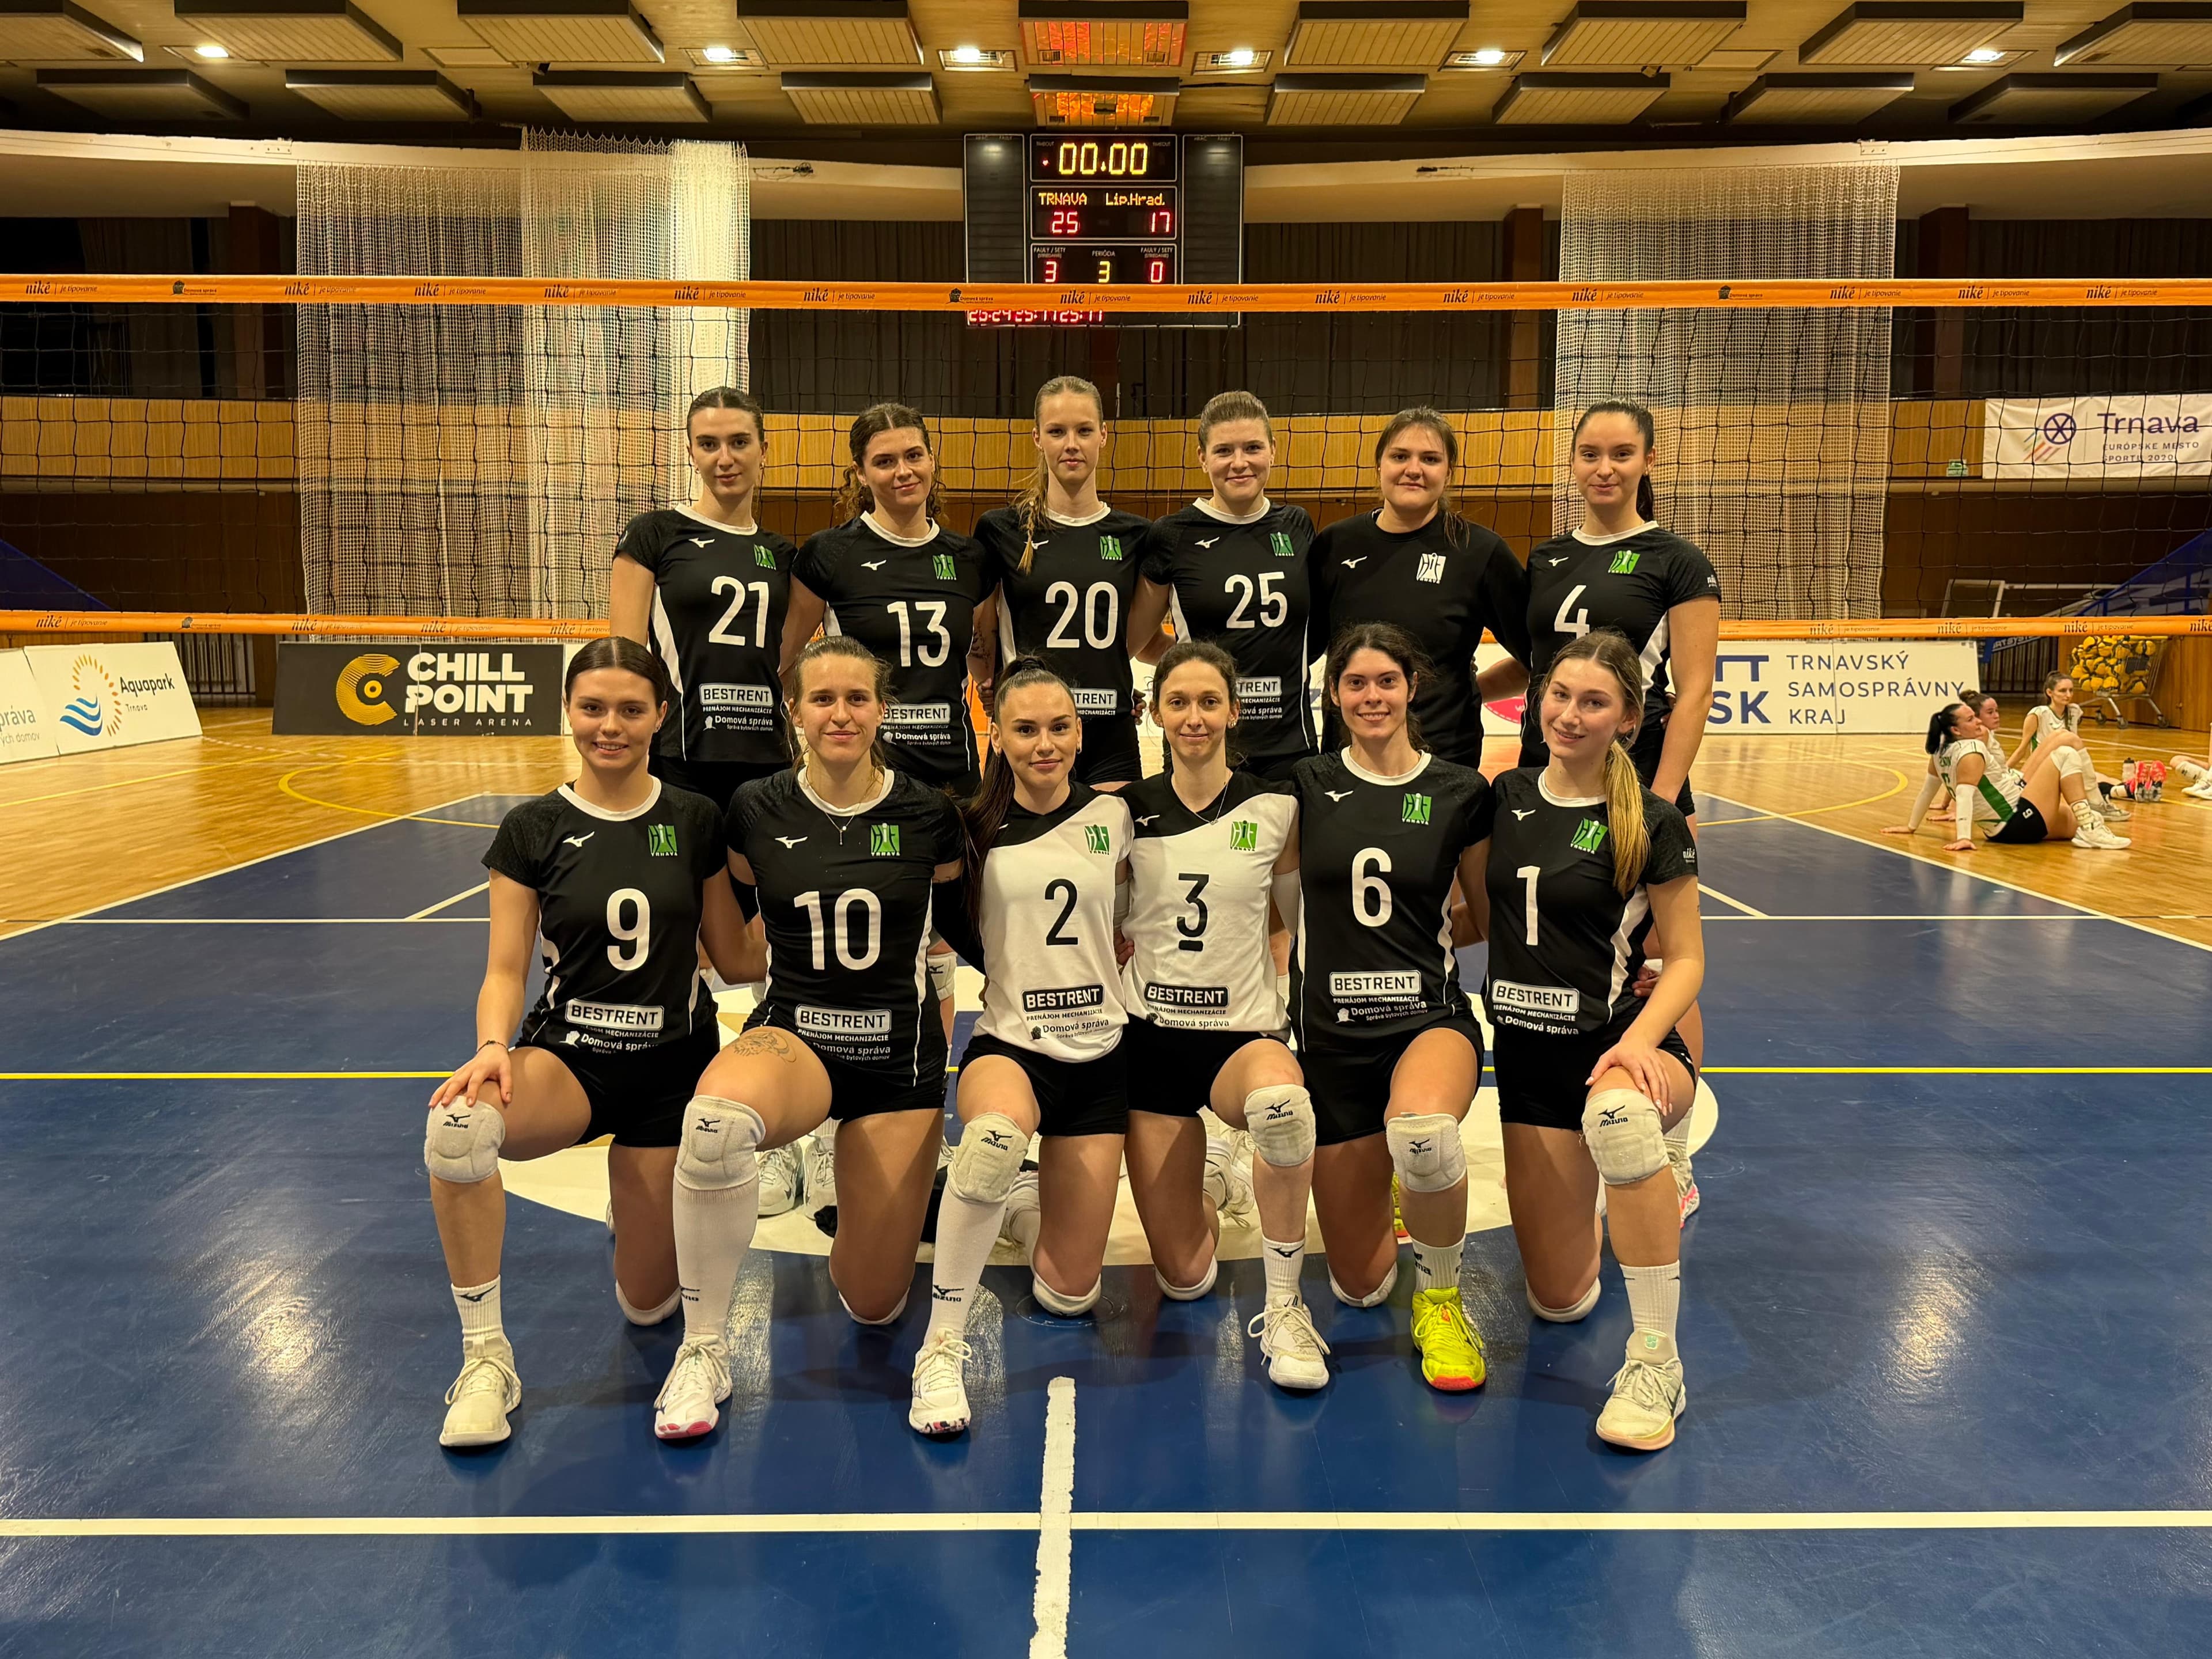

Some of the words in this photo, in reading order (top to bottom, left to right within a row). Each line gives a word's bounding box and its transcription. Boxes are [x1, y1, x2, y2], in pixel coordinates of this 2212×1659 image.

[1038, 192, 1088, 206] TRNAVA
[1052, 211, 1078, 233] 25
[1152, 212, 1171, 232] 17
[1045, 261, 1057, 282] 3
[1099, 261, 1110, 283] 3
[1150, 261, 1163, 283] 0
[25, 281, 50, 294] niké
[285, 282, 309, 296] niké
[414, 283, 439, 297] niké
[544, 284, 569, 298] niké
[674, 286, 699, 300] niké
[804, 287, 828, 301] niké
[1443, 289, 1468, 302] niké
[1572, 287, 1597, 301] niké
[1830, 285, 1855, 299] niké
[1958, 285, 1983, 299] niké
[2086, 285, 2111, 298] niké
[1060, 290, 1085, 304] niké
[1187, 290, 1212, 304] niké
[1315, 290, 1340, 304] niké
[2097, 412, 2199, 434] Trnava
[1224, 571, 1287, 628] 25
[709, 576, 769, 649] 21
[1045, 581, 1118, 649] 20
[1555, 585, 1590, 639] 4
[887, 601, 951, 668] 13
[408, 653, 525, 681] CHILL
[1786, 650, 1909, 670] TRNAVSKÝ
[120, 673, 175, 697] Aquapark
[1237, 681, 1278, 692] TRENT
[1788, 677, 1965, 697] SAMOSPRÁVNY
[405, 684, 533, 713] POINT
[704, 688, 769, 702] BESTRENT
[1074, 693, 1113, 704] TRENT
[884, 708, 948, 719] BESTRENT
[1259, 706, 1282, 715] správa
[1707, 691, 1771, 724] SK
[715, 715, 747, 724] Domová
[749, 717, 773, 727] správa
[1790, 709, 1846, 725] KRAJ
[895, 732, 928, 740] Domová
[930, 732, 950, 741] správa
[1352, 847, 1392, 927] 6
[1044, 878, 1078, 945] 2
[1177, 873, 1209, 937] 3
[1517, 865, 1540, 946] 1
[607, 888, 650, 971] 9
[794, 888, 881, 971] 10
[1335, 976, 1415, 991] BESTRENT
[1026, 988, 1100, 1008] BESTRENT
[1147, 986, 1225, 1004] BESTRENT
[1497, 986, 1573, 1007] BESTRENT
[571, 1005, 658, 1025] BESTRENT
[1351, 1005, 1391, 1016] Domová
[1394, 1001, 1427, 1012] správa
[801, 1010, 885, 1028] BESTRENT
[1043, 1021, 1079, 1033] Domová
[1082, 1018, 1109, 1030] správa
[1160, 1016, 1195, 1027] Domová
[1199, 1018, 1229, 1029] správa
[1505, 1016, 1544, 1031] Domová
[1546, 1025, 1579, 1035] správa
[581, 1033, 622, 1050] Domová
[626, 1041, 658, 1052] sprá
[858, 1046, 891, 1056] správa
